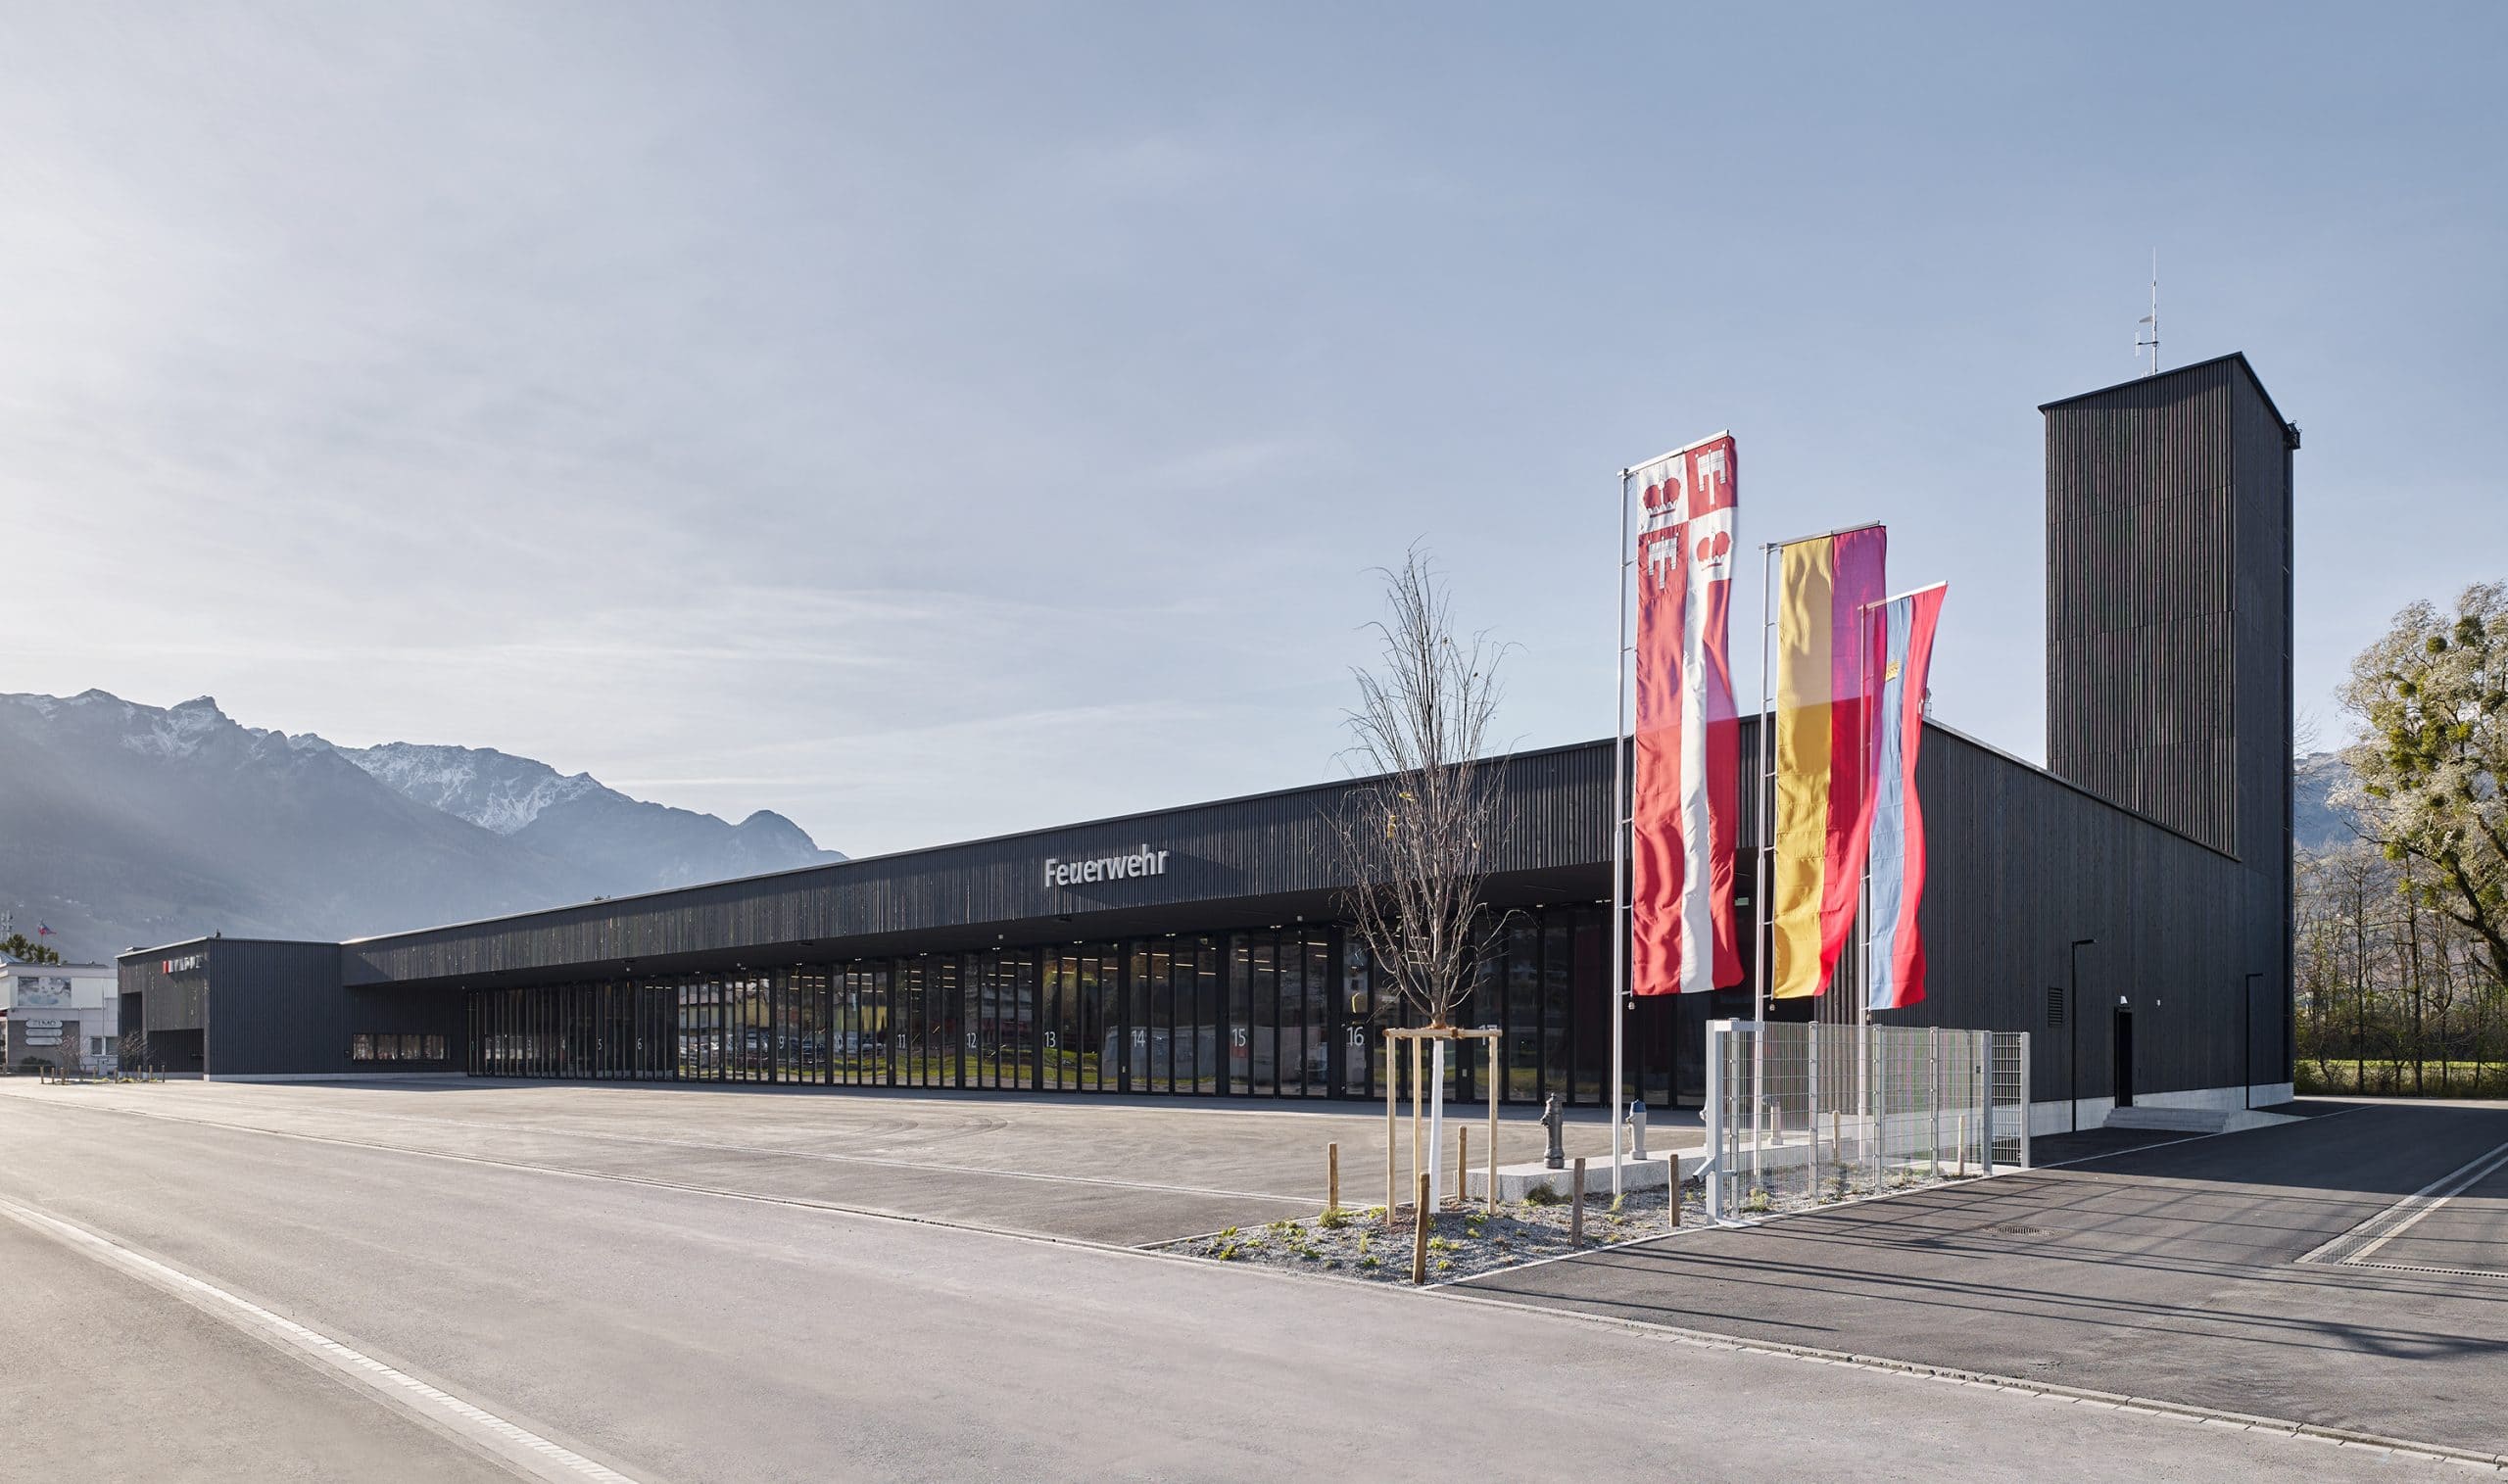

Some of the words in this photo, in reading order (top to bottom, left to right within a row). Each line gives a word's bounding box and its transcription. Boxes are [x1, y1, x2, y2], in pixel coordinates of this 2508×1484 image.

[1045, 843, 1169, 887] Feuerwehr
[637, 1037, 643, 1050] 6
[779, 1035, 785, 1049] 9
[834, 1034, 844, 1049] 10
[897, 1033, 906, 1048] 11
[966, 1032, 977, 1048] 12
[1044, 1030, 1056, 1048] 13
[1131, 1029, 1145, 1047] 14
[1231, 1029, 1246, 1047] 15
[1346, 1026, 1365, 1046] 16
[1478, 1024, 1498, 1046] 1
[598, 1038, 603, 1051] 5
